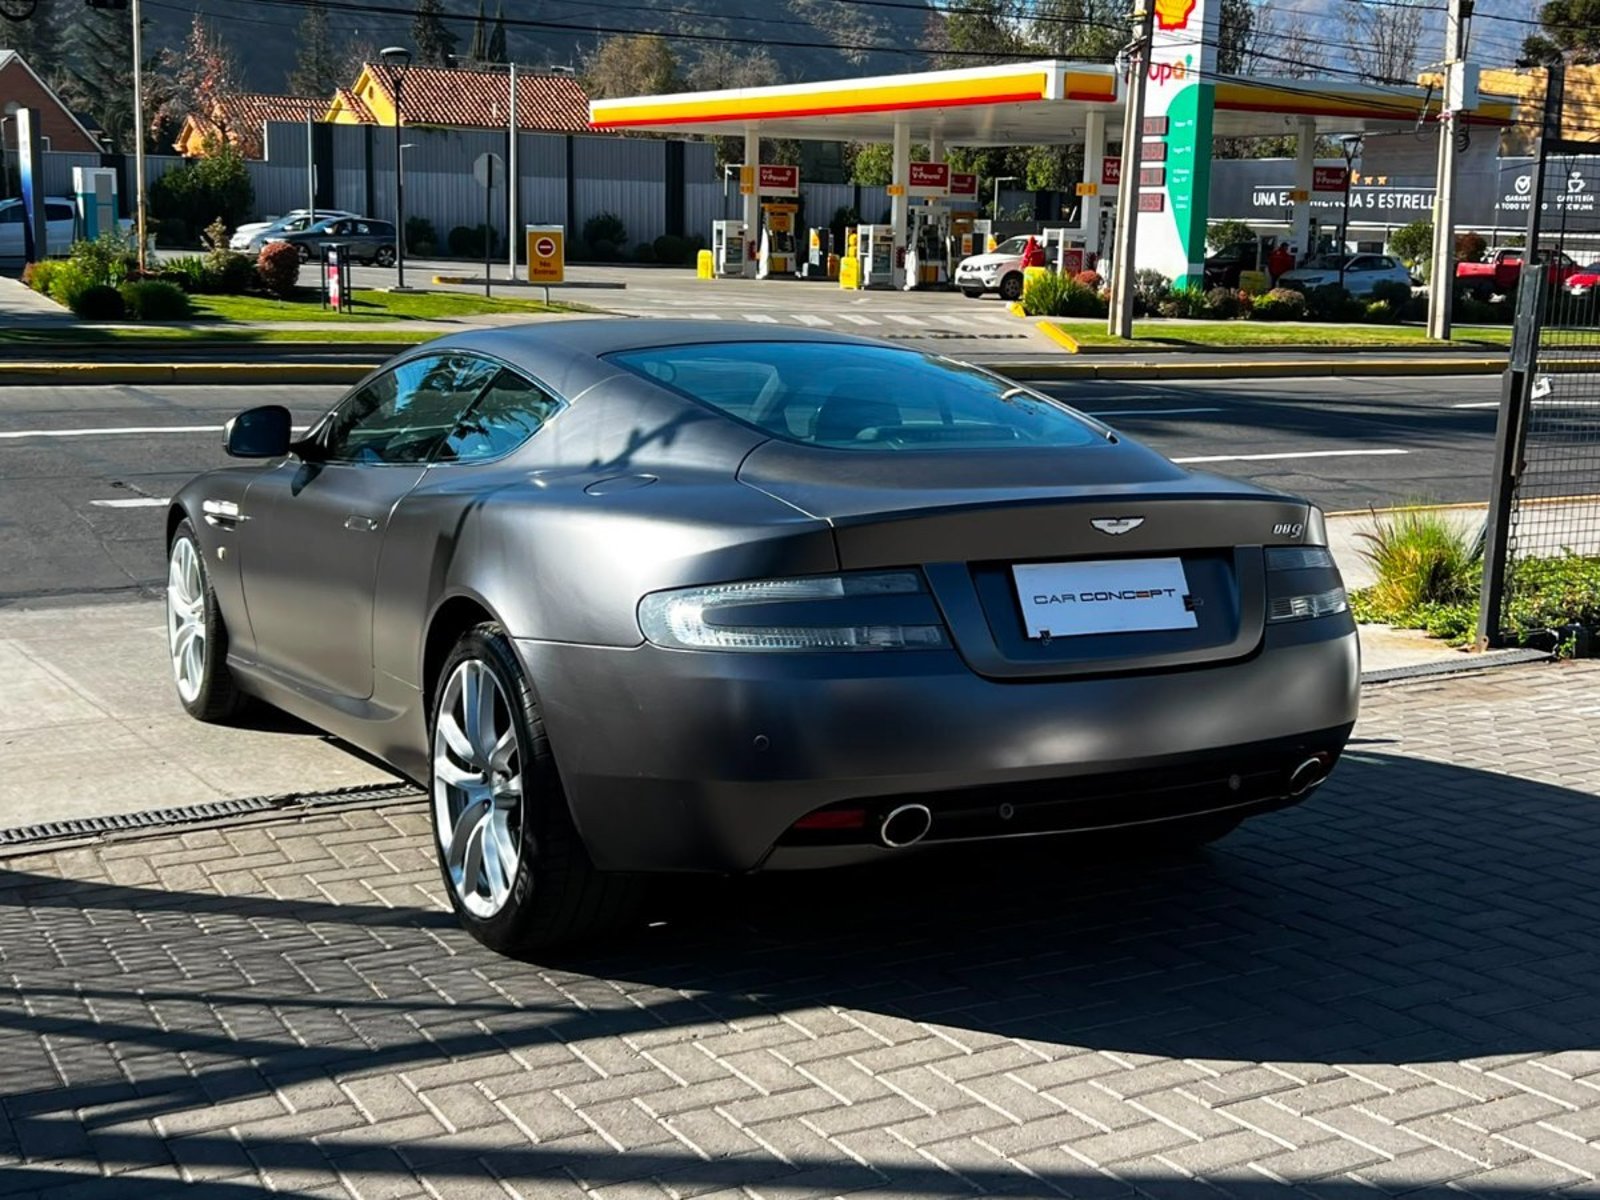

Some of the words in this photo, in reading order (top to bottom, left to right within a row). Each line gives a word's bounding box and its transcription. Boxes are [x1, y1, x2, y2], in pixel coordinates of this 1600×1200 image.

[1252, 192, 1277, 206] UNA
[1366, 193, 1375, 208] 5
[1378, 193, 1436, 210] ESTRELL
[1272, 523, 1303, 538] DB9
[1033, 594, 1076, 605] CAR
[1079, 588, 1176, 602] CONCEPT
